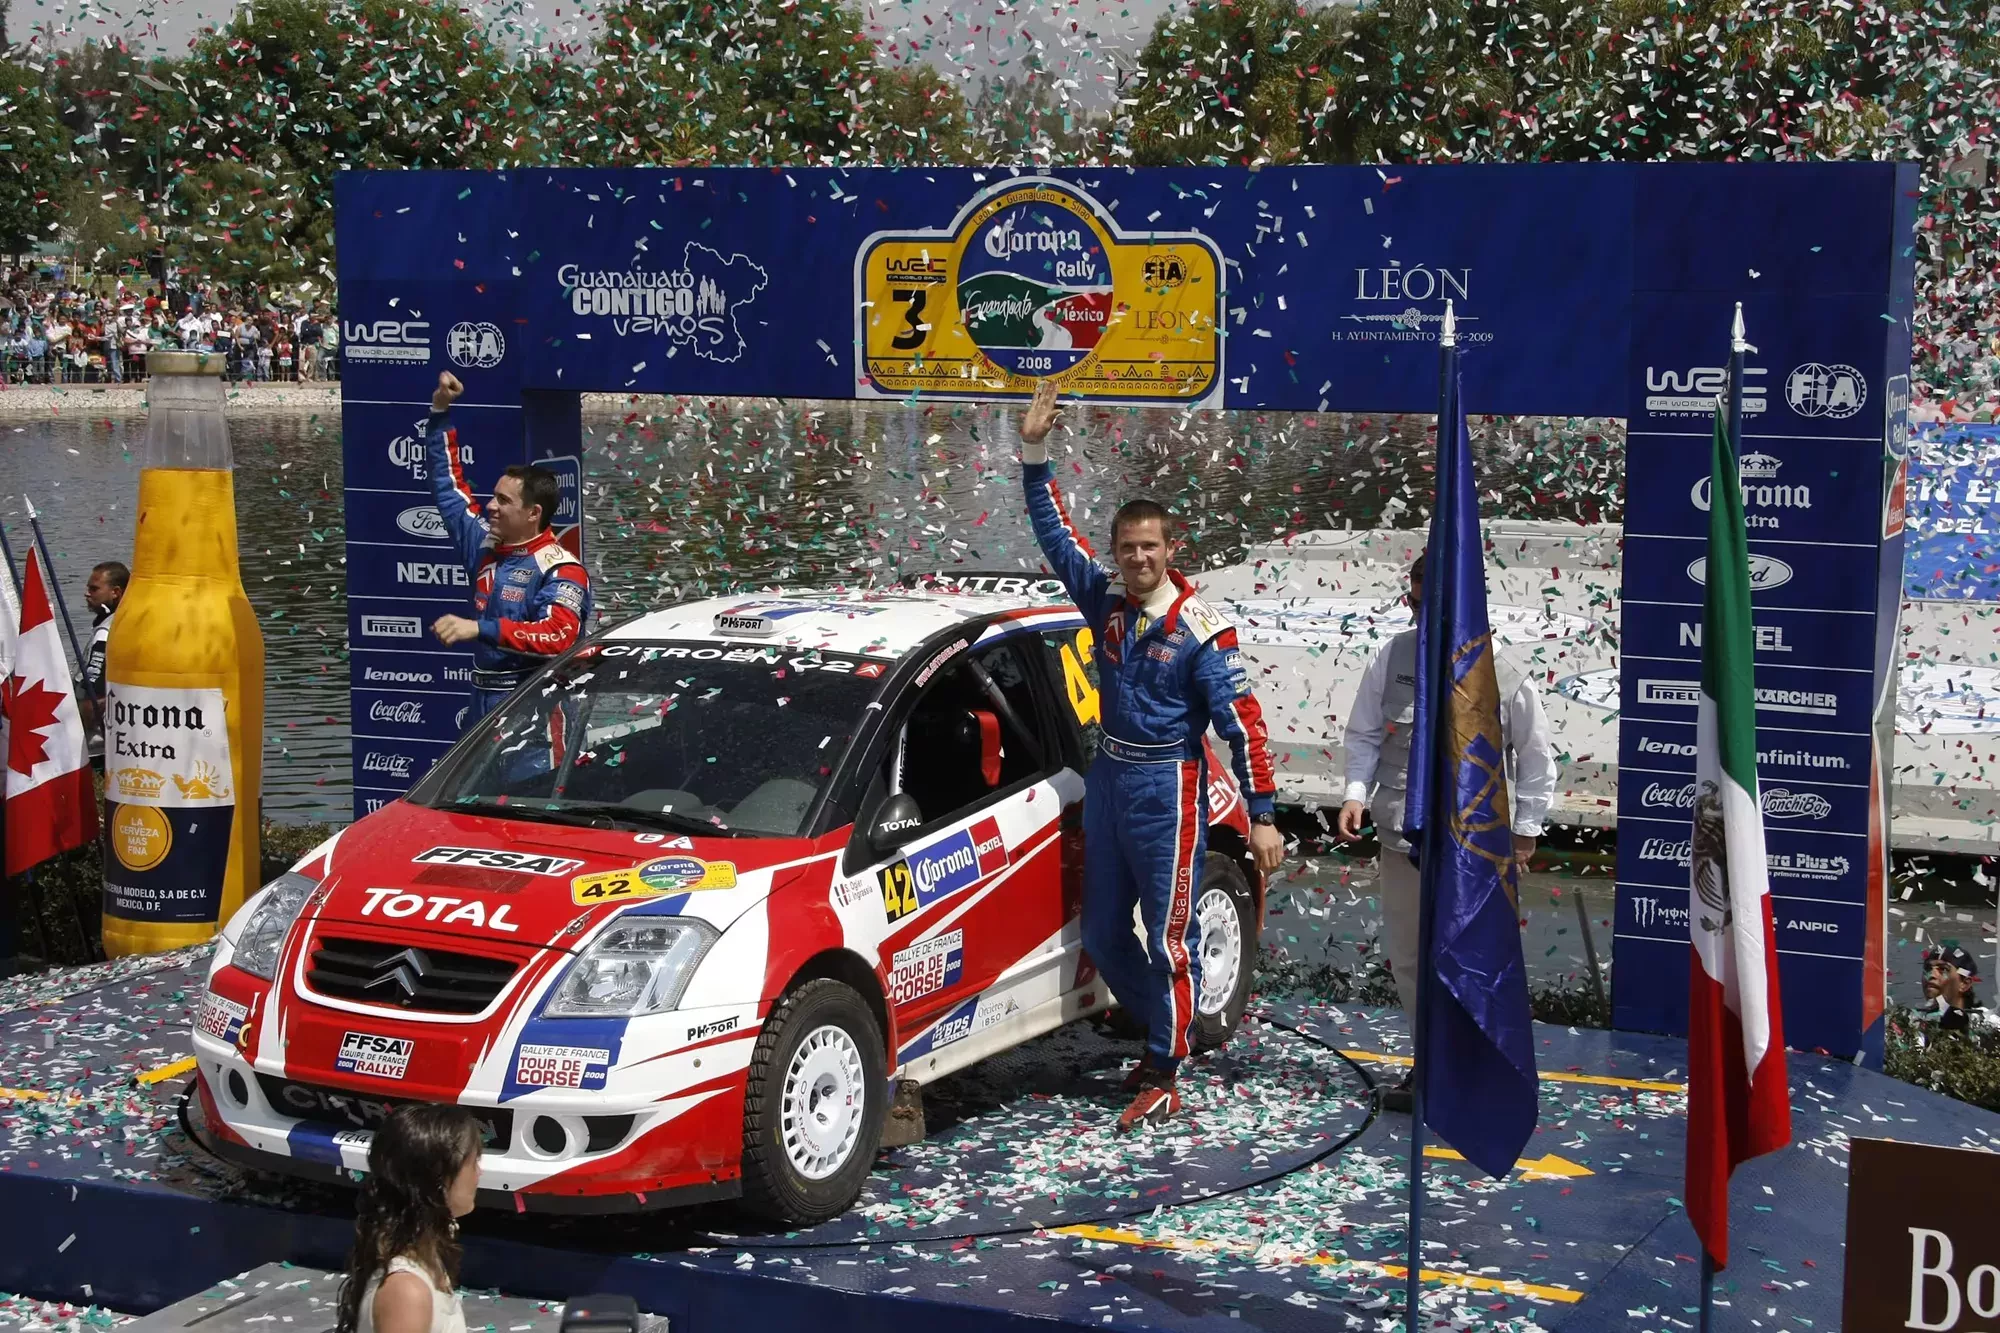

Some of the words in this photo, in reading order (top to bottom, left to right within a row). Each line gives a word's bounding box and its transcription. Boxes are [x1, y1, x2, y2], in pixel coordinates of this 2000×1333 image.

[1006, 191, 1055, 203] Guanajuato
[1070, 200, 1091, 221] Silao
[984, 216, 1083, 261] Corona
[886, 257, 947, 273] WRC
[1056, 260, 1096, 280] Rally
[558, 264, 694, 289] Guanajuato
[572, 288, 694, 316] CONTIGO
[891, 289, 926, 350] 3
[1056, 303, 1104, 323] México
[344, 320, 430, 343] WRC
[1332, 331, 1344, 341] H.
[1347, 331, 1436, 341] AYUNTAMIENTO
[1017, 356, 1052, 370] 2008
[1646, 366, 1768, 393] WRC
[1671, 400, 1716, 408] WORLD
[1937, 517, 1989, 534] DEL
[367, 619, 416, 634] PIRELLI
[364, 667, 432, 683] lenovo
[1754, 688, 1837, 708] KÄRCHER
[115, 731, 176, 760] Extra
[1637, 737, 1698, 756] leno
[362, 752, 413, 772] Hertz
[1756, 750, 1846, 769] nfinitum
[131, 817, 144, 826] LA
[880, 817, 921, 832] TOTAL
[119, 826, 160, 837] CERVEZA
[127, 846, 148, 856] FINA
[128, 837, 148, 846] MAS
[975, 835, 1003, 857] NEXTEL
[1639, 838, 1691, 860] Hert
[416, 848, 552, 873] FFSA
[647, 862, 696, 873] Corona
[915, 846, 974, 892] Corona
[124, 887, 157, 899] MODELO,
[177, 890, 188, 899] DE
[581, 880, 632, 898] 42
[884, 866, 917, 918] 42
[116, 898, 144, 911] MEXICO,
[361, 887, 519, 932] TOTAL
[1786, 919, 1838, 933] ANPIC
[891, 945, 920, 965] RALLYE
[922, 942, 932, 955] DE
[933, 930, 962, 950] FRANCE
[893, 960, 925, 985] TOUR
[928, 952, 943, 972] DE
[892, 969, 943, 1004] CORSE
[217, 1010, 231, 1024] DE
[944, 1014, 970, 1037] BPS
[981, 1013, 1002, 1027] 1850
[343, 1033, 402, 1056] FFSA
[521, 1046, 554, 1055] RALLYE
[557, 1048, 569, 1057] DE
[570, 1050, 608, 1060] FRANCE
[340, 1049, 364, 1059] EQUIPE
[378, 1055, 407, 1065] FRANCE
[520, 1057, 556, 1071] TOUR
[560, 1060, 581, 1072] DE
[356, 1060, 404, 1077] RALLYE
[517, 1069, 579, 1087] CORSE
[798, 1116, 821, 1153] RACING
